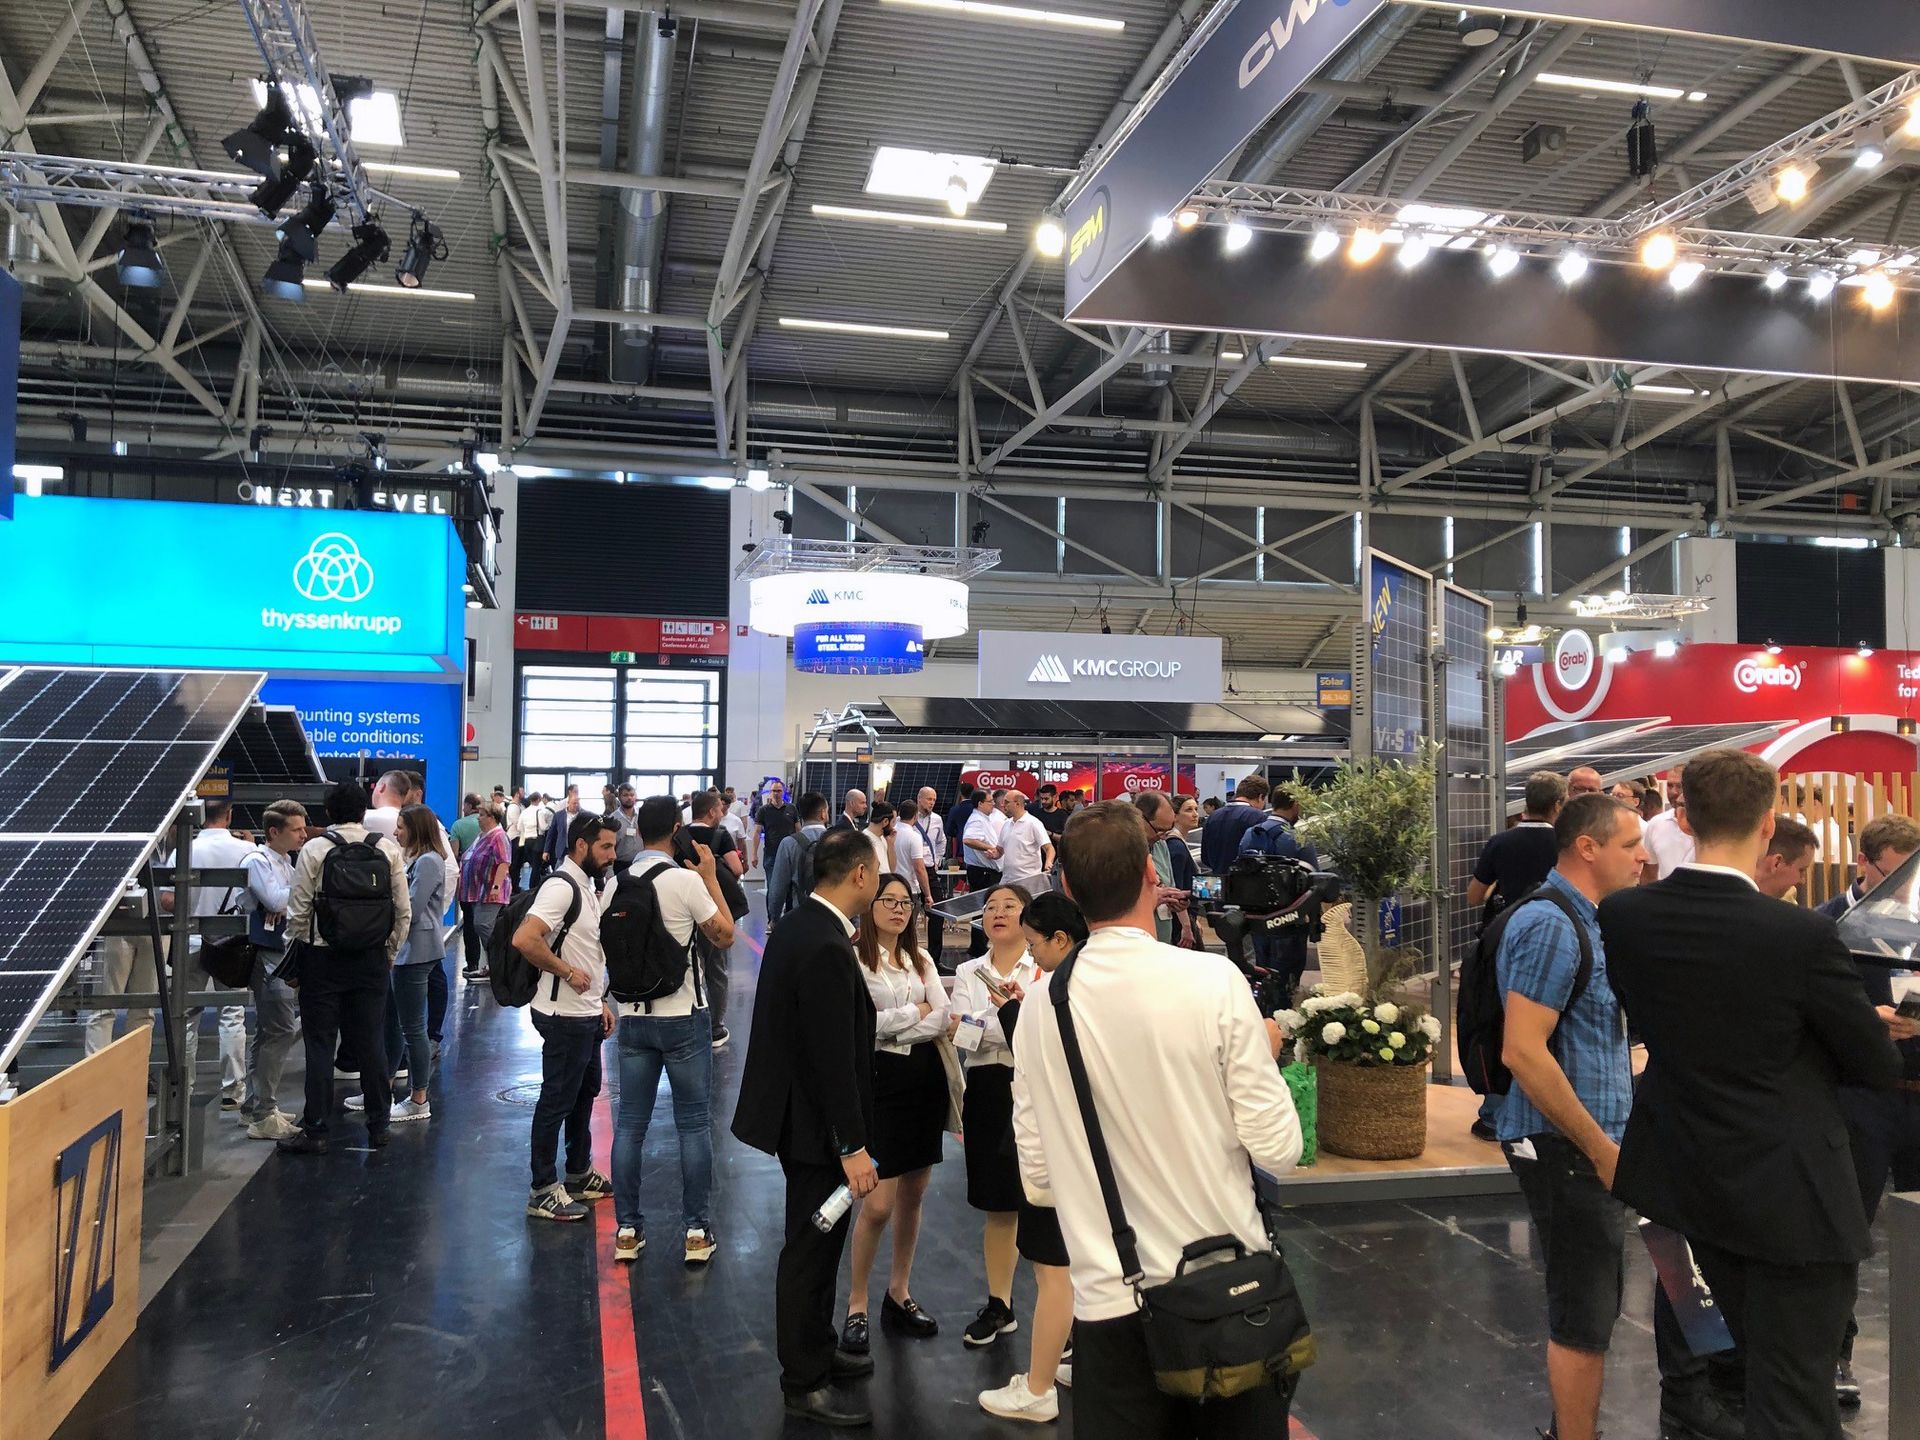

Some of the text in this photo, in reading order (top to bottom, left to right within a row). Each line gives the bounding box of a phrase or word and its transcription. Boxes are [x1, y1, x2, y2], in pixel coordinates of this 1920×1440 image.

[255, 485, 447, 514] NEXT EVEL
[834, 591, 864, 601] KMC
[261, 608, 402, 635] thyssenkrupp
[1494, 650, 1524, 665] LAR
[1898, 683, 1918, 697] for
[297, 708, 420, 725] ounting systems
[306, 728, 424, 745] able conditions:
[207, 765, 229, 774] olar
[1016, 760, 1073, 771] sysems
[1266, 911, 1299, 930] RONIN
[1229, 1280, 1260, 1296] Canon
